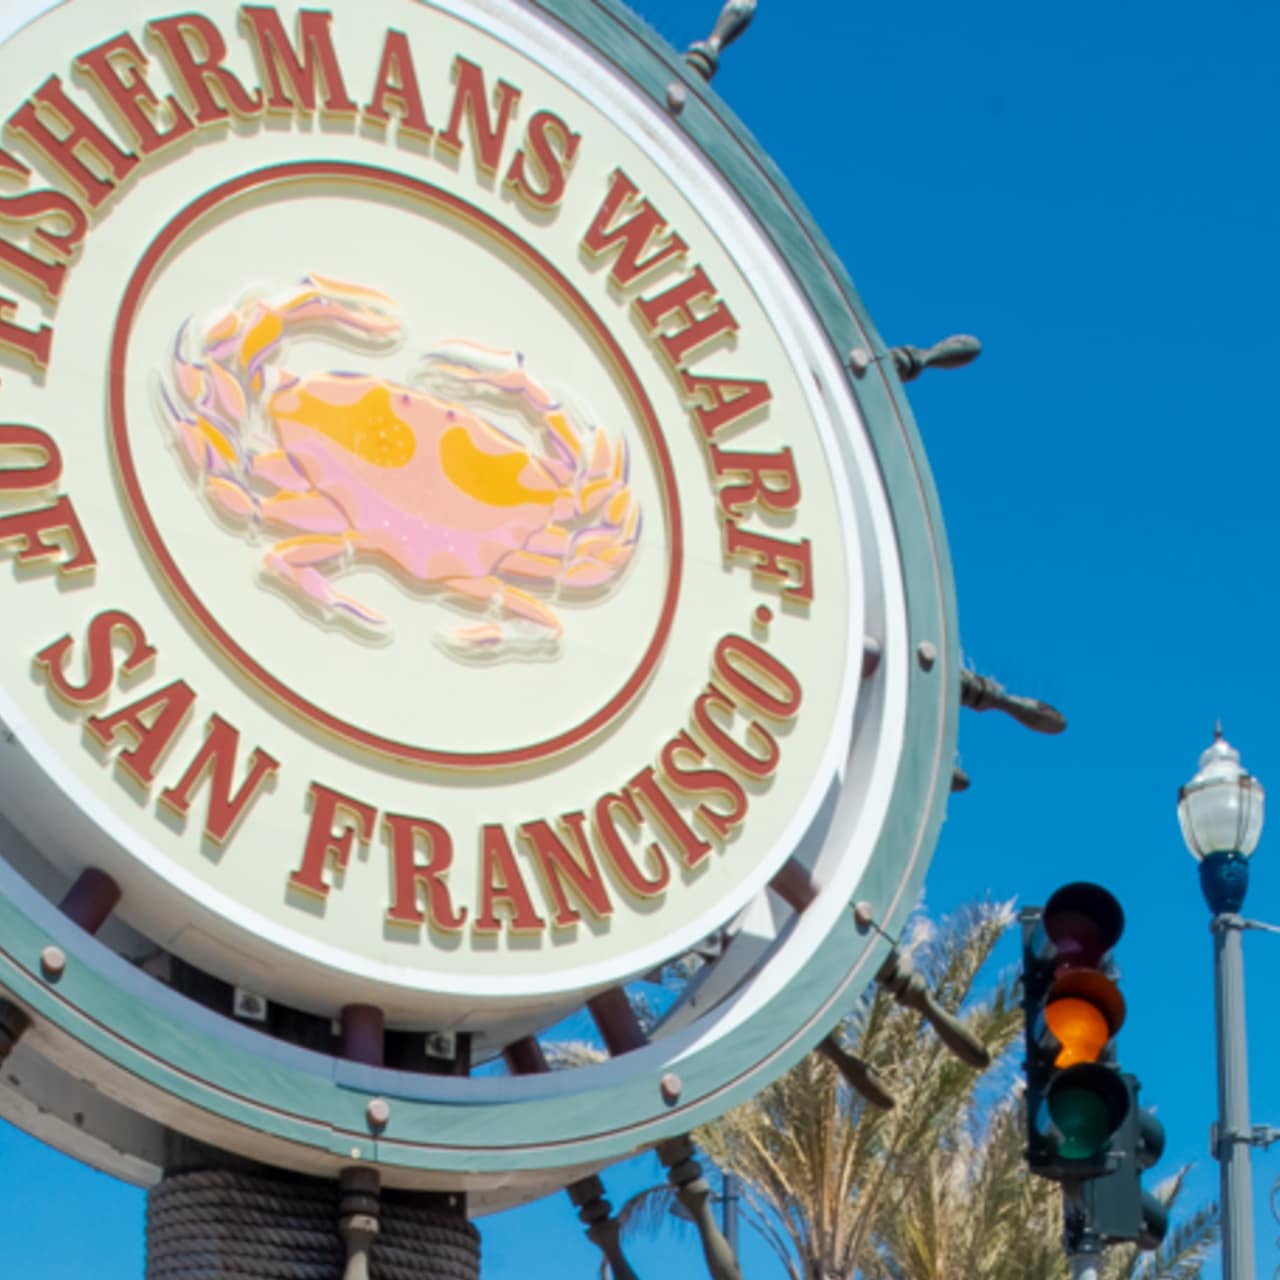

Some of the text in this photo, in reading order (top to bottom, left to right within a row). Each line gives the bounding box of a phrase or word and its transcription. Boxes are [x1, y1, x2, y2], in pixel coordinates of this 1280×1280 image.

[578, 168, 816, 614] WHARF
[35, 608, 279, 846] SAN
[286, 632, 803, 936] FRANCISCO
